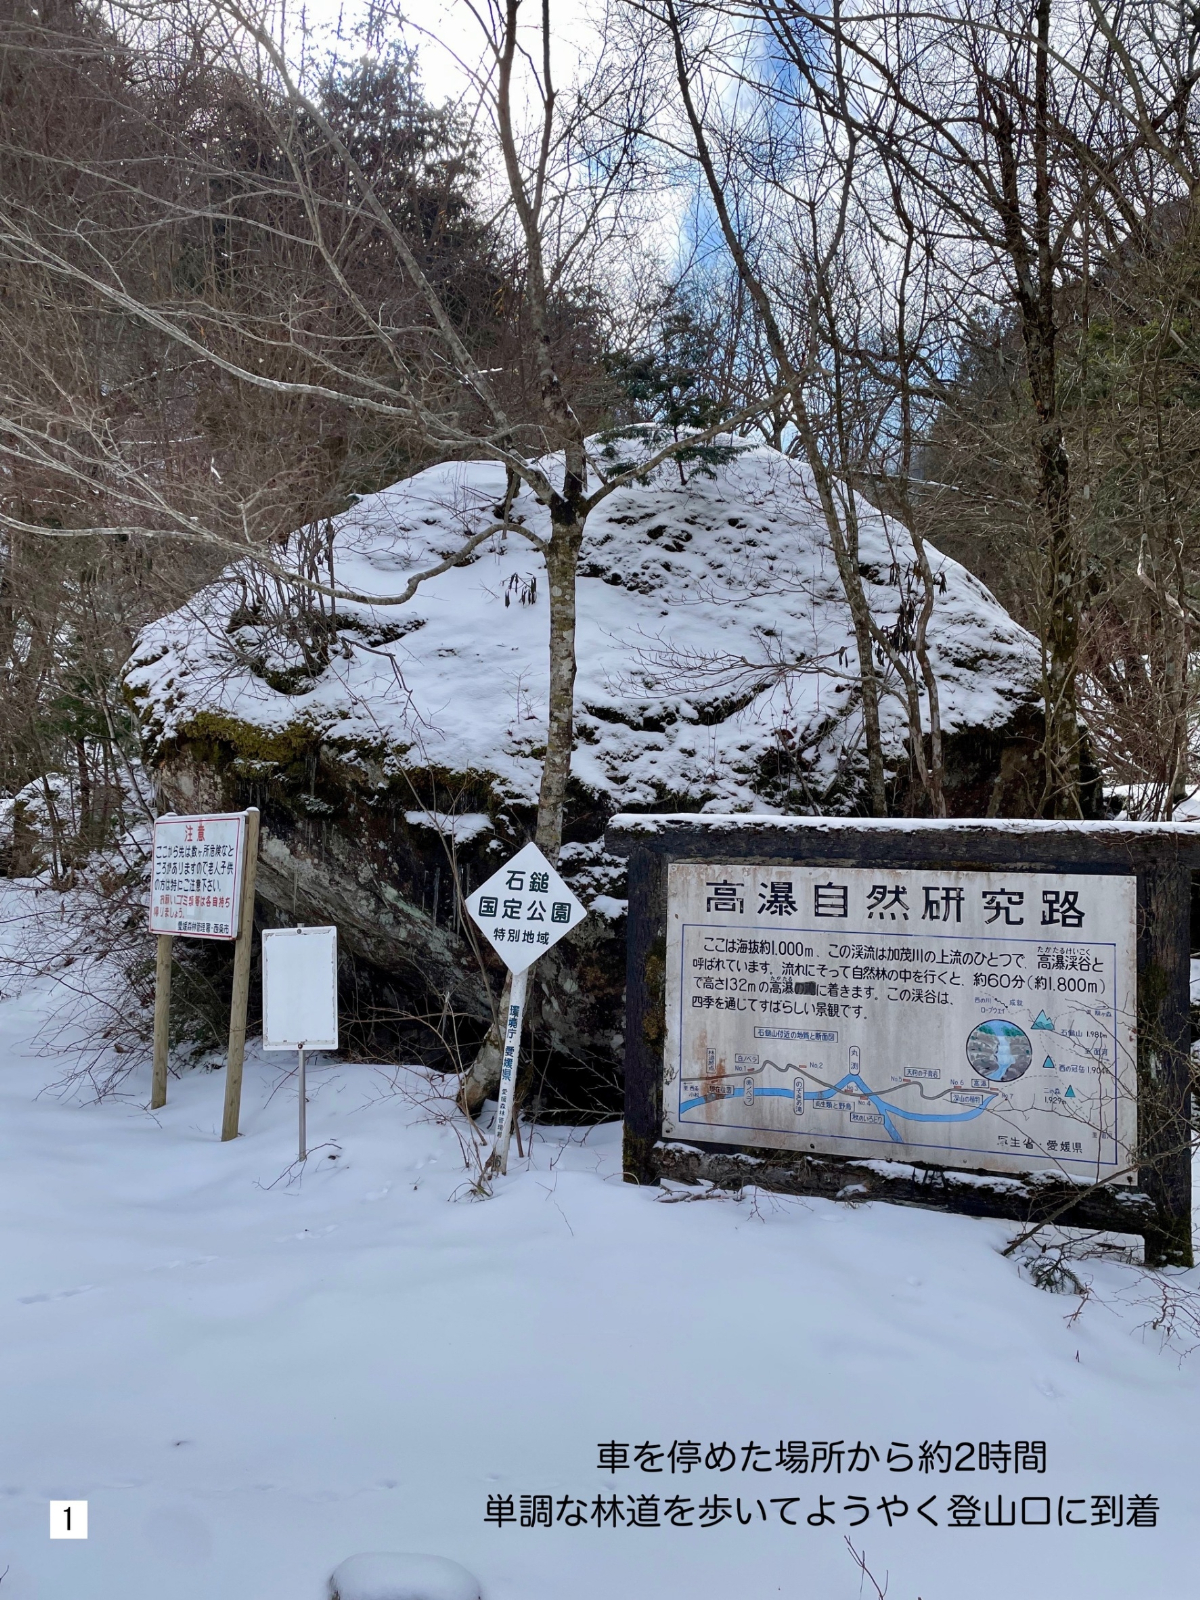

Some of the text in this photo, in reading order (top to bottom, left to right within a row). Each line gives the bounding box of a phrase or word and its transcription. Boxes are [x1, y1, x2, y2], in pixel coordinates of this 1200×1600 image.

[184, 822, 205, 842] 注意
[505, 870, 549, 893] 石鎚
[478, 896, 571, 923] 国定公園
[706, 880, 1086, 928] 高瀑自然研究路
[493, 927, 549, 945] 特別地域
[692, 996, 868, 1020] 四季を通じてすばらしい景観です。
